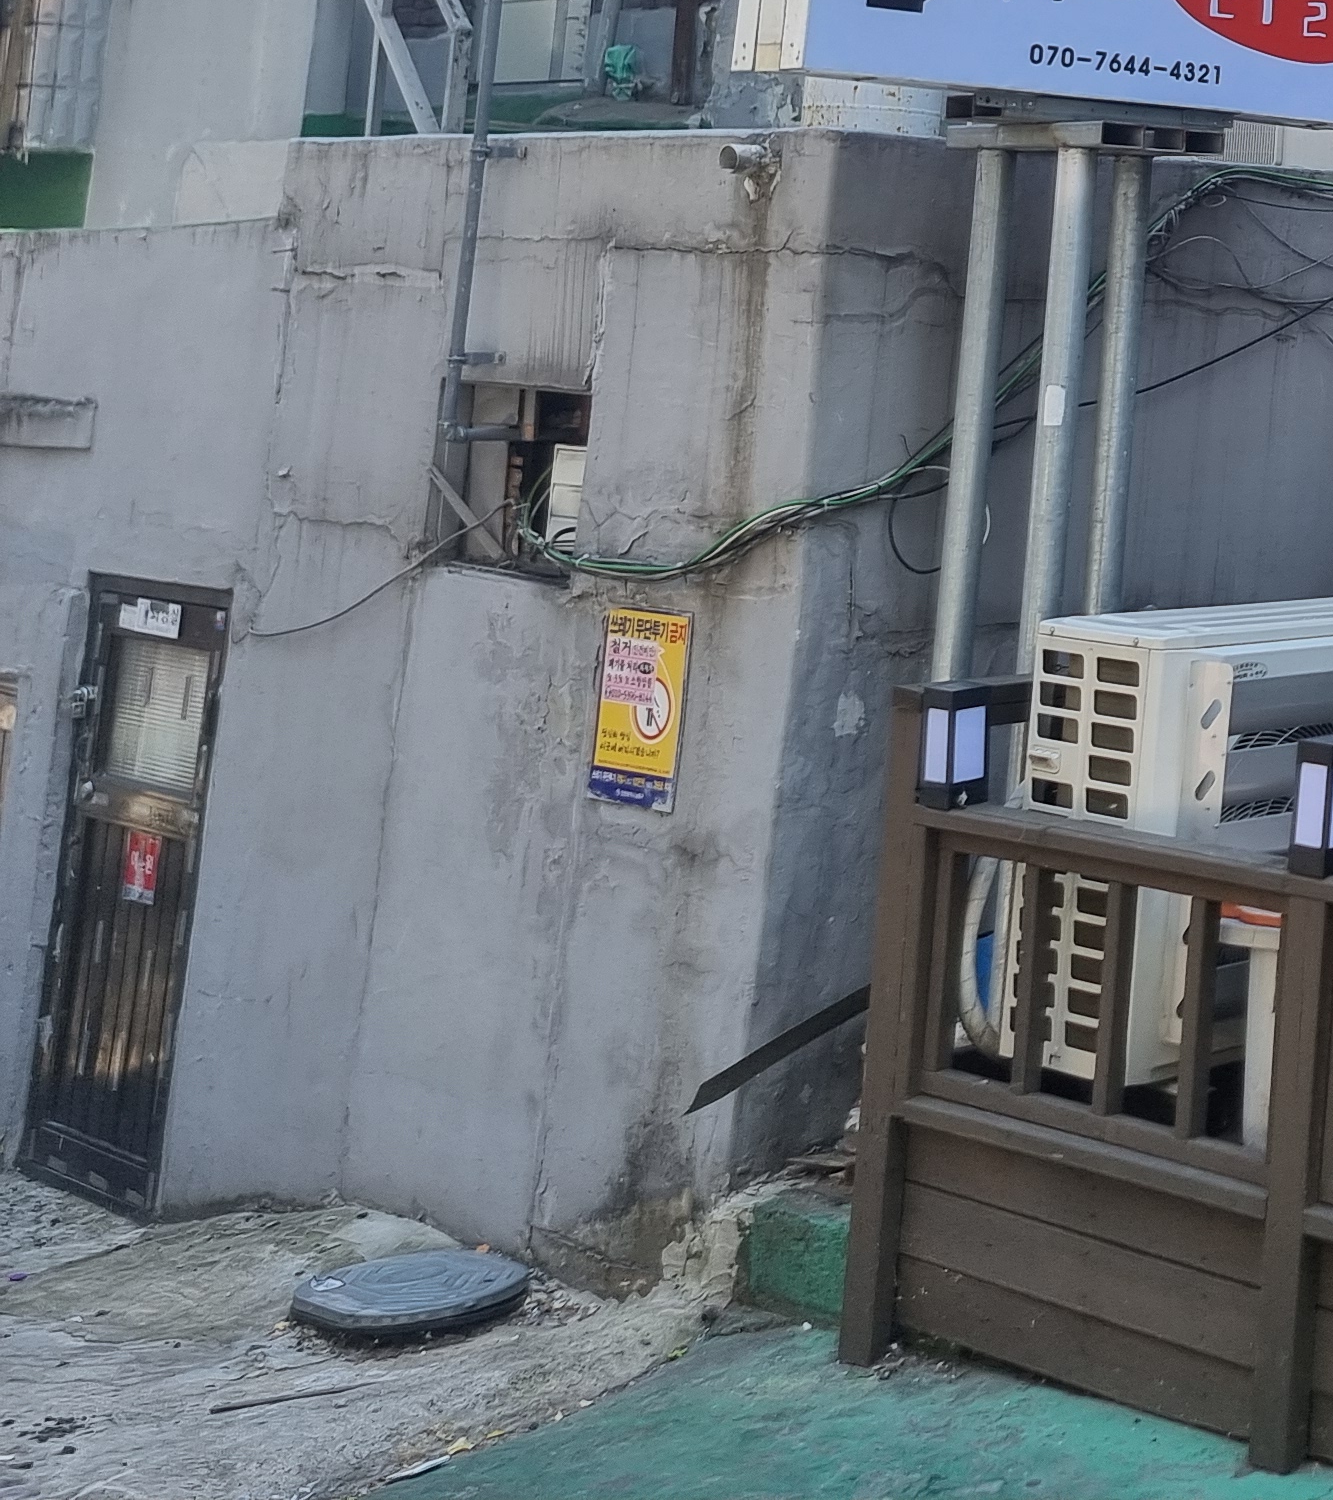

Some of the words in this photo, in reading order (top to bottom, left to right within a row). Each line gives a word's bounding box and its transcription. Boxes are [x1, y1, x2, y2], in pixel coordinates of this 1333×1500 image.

[1030, 44, 1222, 84] 070-7644-4321
[609, 615, 635, 638] 쓰레기
[635, 618, 669, 642] 무단투기
[669, 622, 688, 645] 금지
